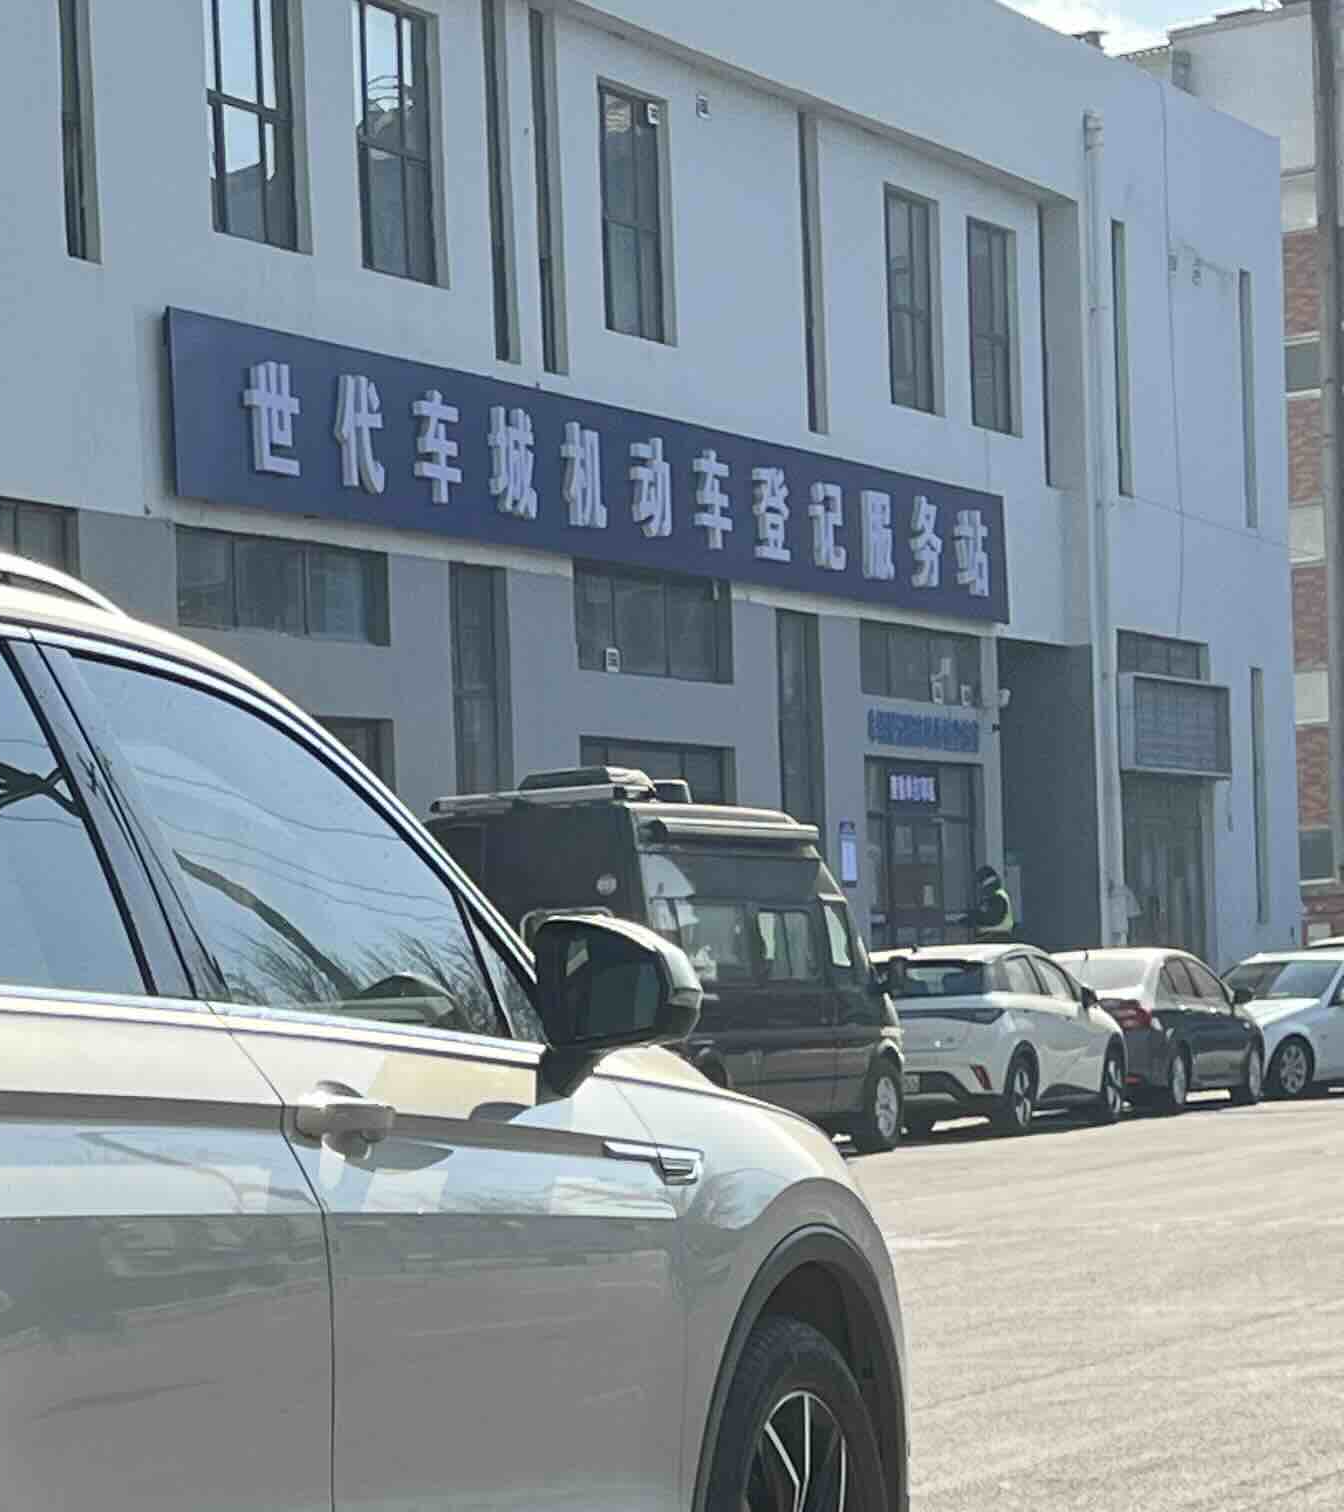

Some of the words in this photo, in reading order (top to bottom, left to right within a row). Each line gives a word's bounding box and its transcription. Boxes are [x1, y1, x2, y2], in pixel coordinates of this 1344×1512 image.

[242, 359, 992, 598] 世代车城机动车登记服务站
